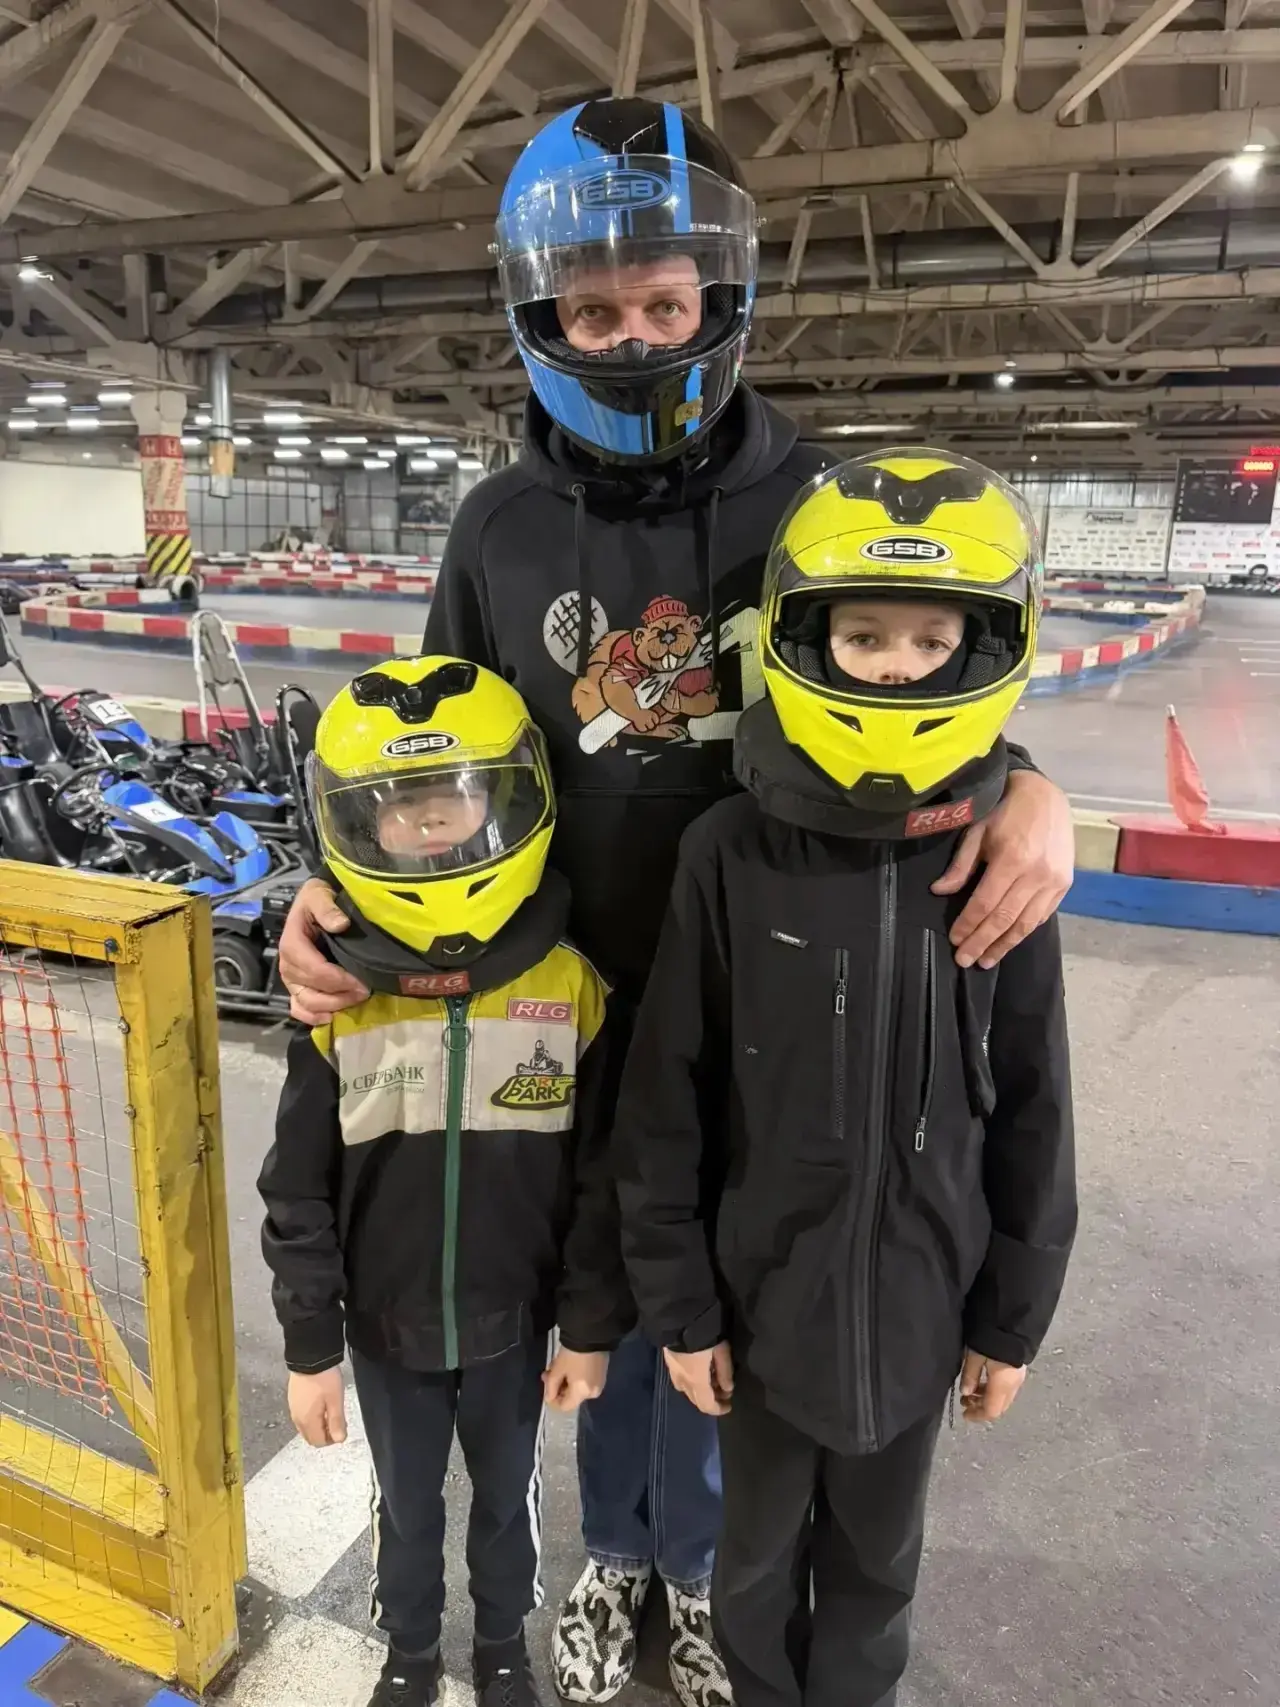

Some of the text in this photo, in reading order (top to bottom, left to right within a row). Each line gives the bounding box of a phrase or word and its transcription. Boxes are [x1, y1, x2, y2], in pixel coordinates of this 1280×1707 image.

[581, 179, 654, 202] GSB
[871, 542, 938, 557] GSB
[391, 735, 449, 754] GSB
[911, 803, 971, 828] RLG
[407, 975, 464, 990] RLG
[515, 1002, 568, 1019] RLG
[511, 1076, 557, 1088] KART
[502, 1086, 563, 1102] PARK
